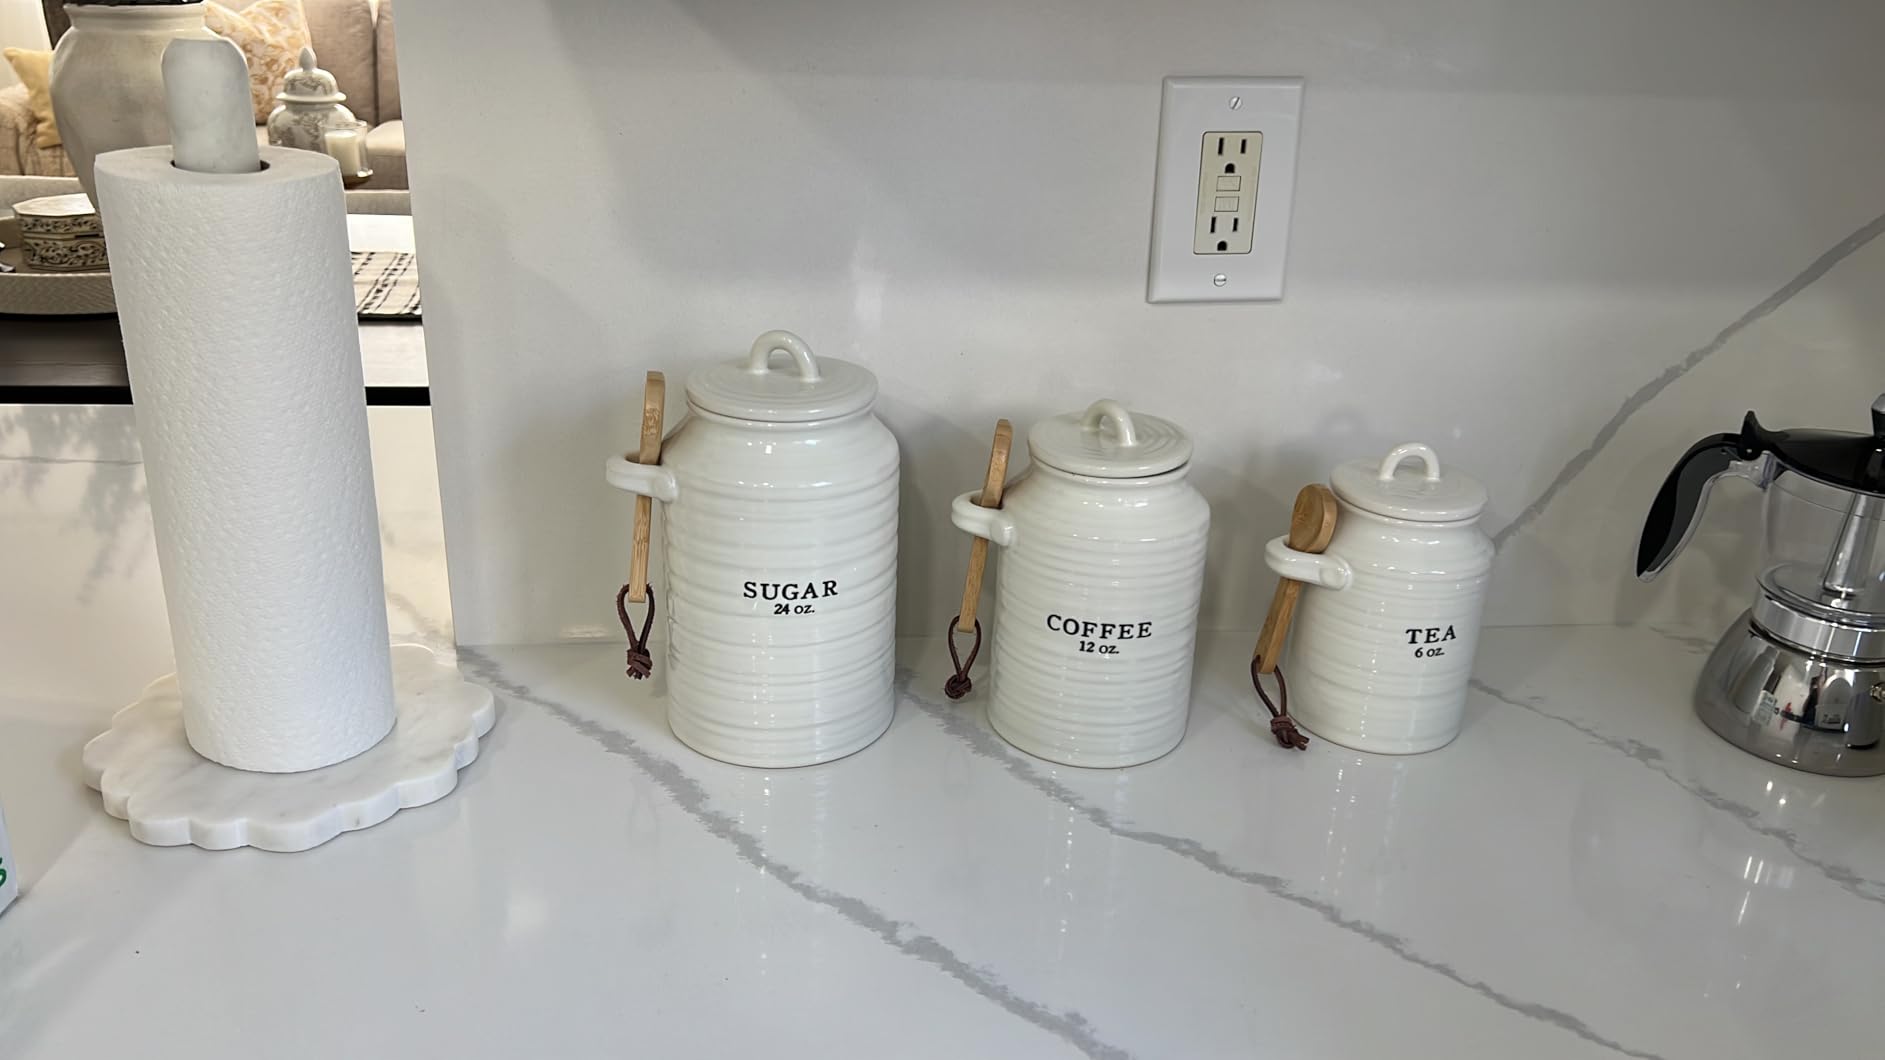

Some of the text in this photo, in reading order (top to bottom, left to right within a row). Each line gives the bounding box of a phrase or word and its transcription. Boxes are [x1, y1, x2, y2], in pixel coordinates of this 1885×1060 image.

[743, 580, 838, 600] SUGAR
[773, 603, 815, 615] 24 oz.
[1047, 614, 1152, 639] COFFEE
[1405, 624, 1456, 644] TEA
[1079, 640, 1120, 654] 12 oz.
[1414, 646, 1423, 658] 6
